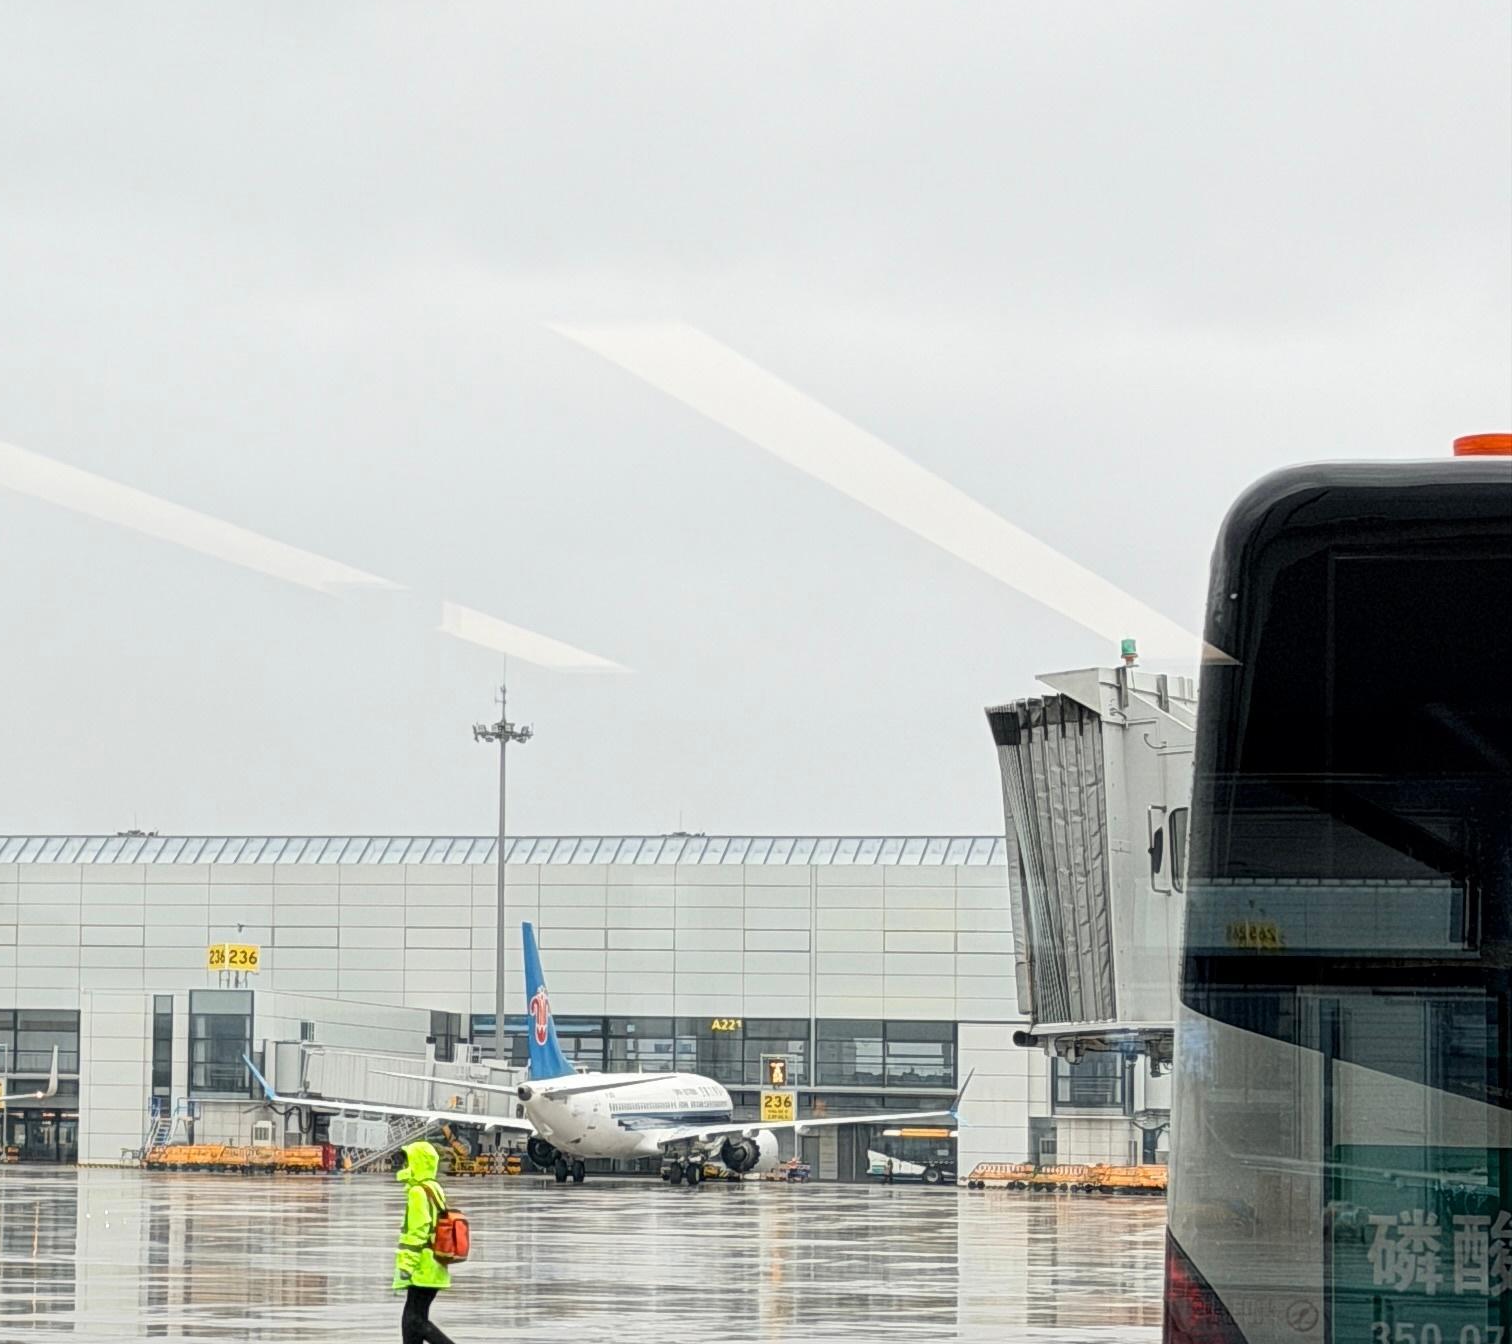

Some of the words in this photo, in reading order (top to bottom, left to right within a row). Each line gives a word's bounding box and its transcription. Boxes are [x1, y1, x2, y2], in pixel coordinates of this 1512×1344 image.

[229, 949, 258, 965] 236
[711, 1019, 742, 1030] A221
[764, 1095, 792, 1108] 236
